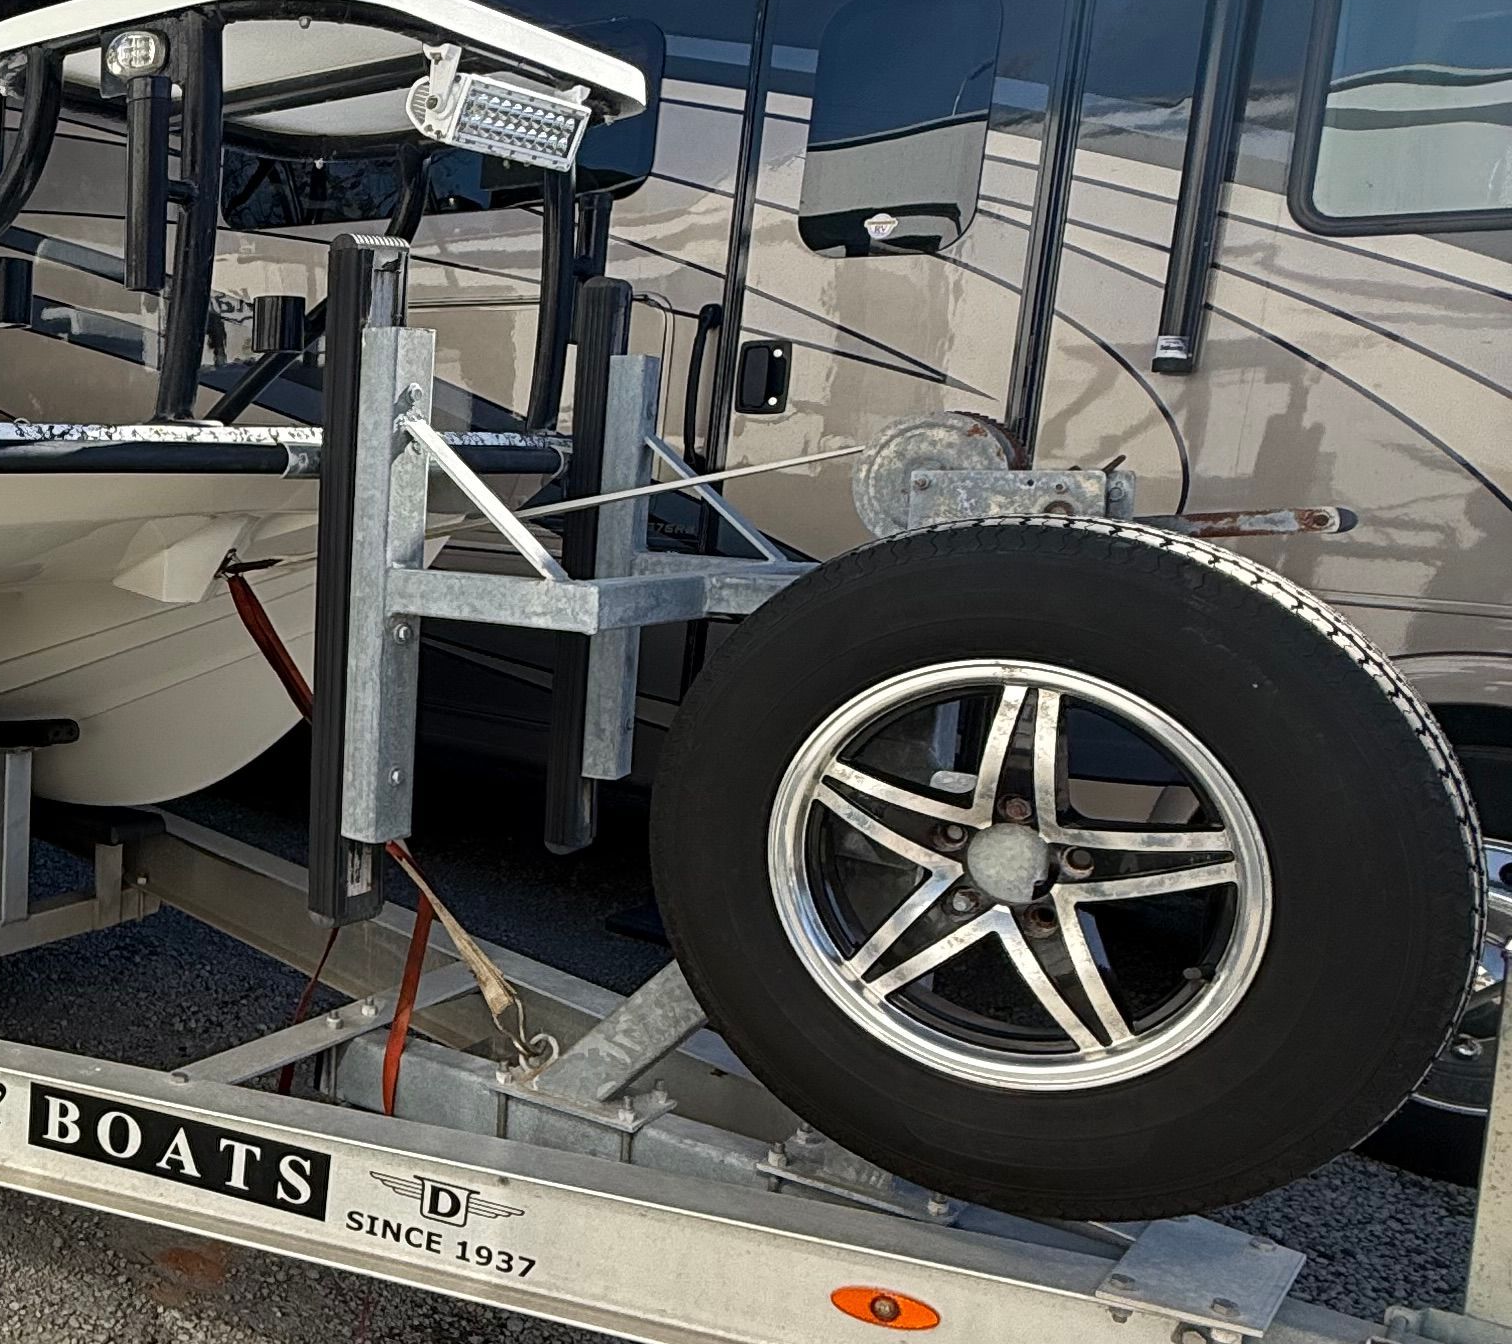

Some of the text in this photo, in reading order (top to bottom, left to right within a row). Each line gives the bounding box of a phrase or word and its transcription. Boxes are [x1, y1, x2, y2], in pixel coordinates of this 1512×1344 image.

[40, 1094, 312, 1205] BOATS
[427, 1183, 462, 1218] D
[345, 1210, 537, 1278] SINCE 1937
